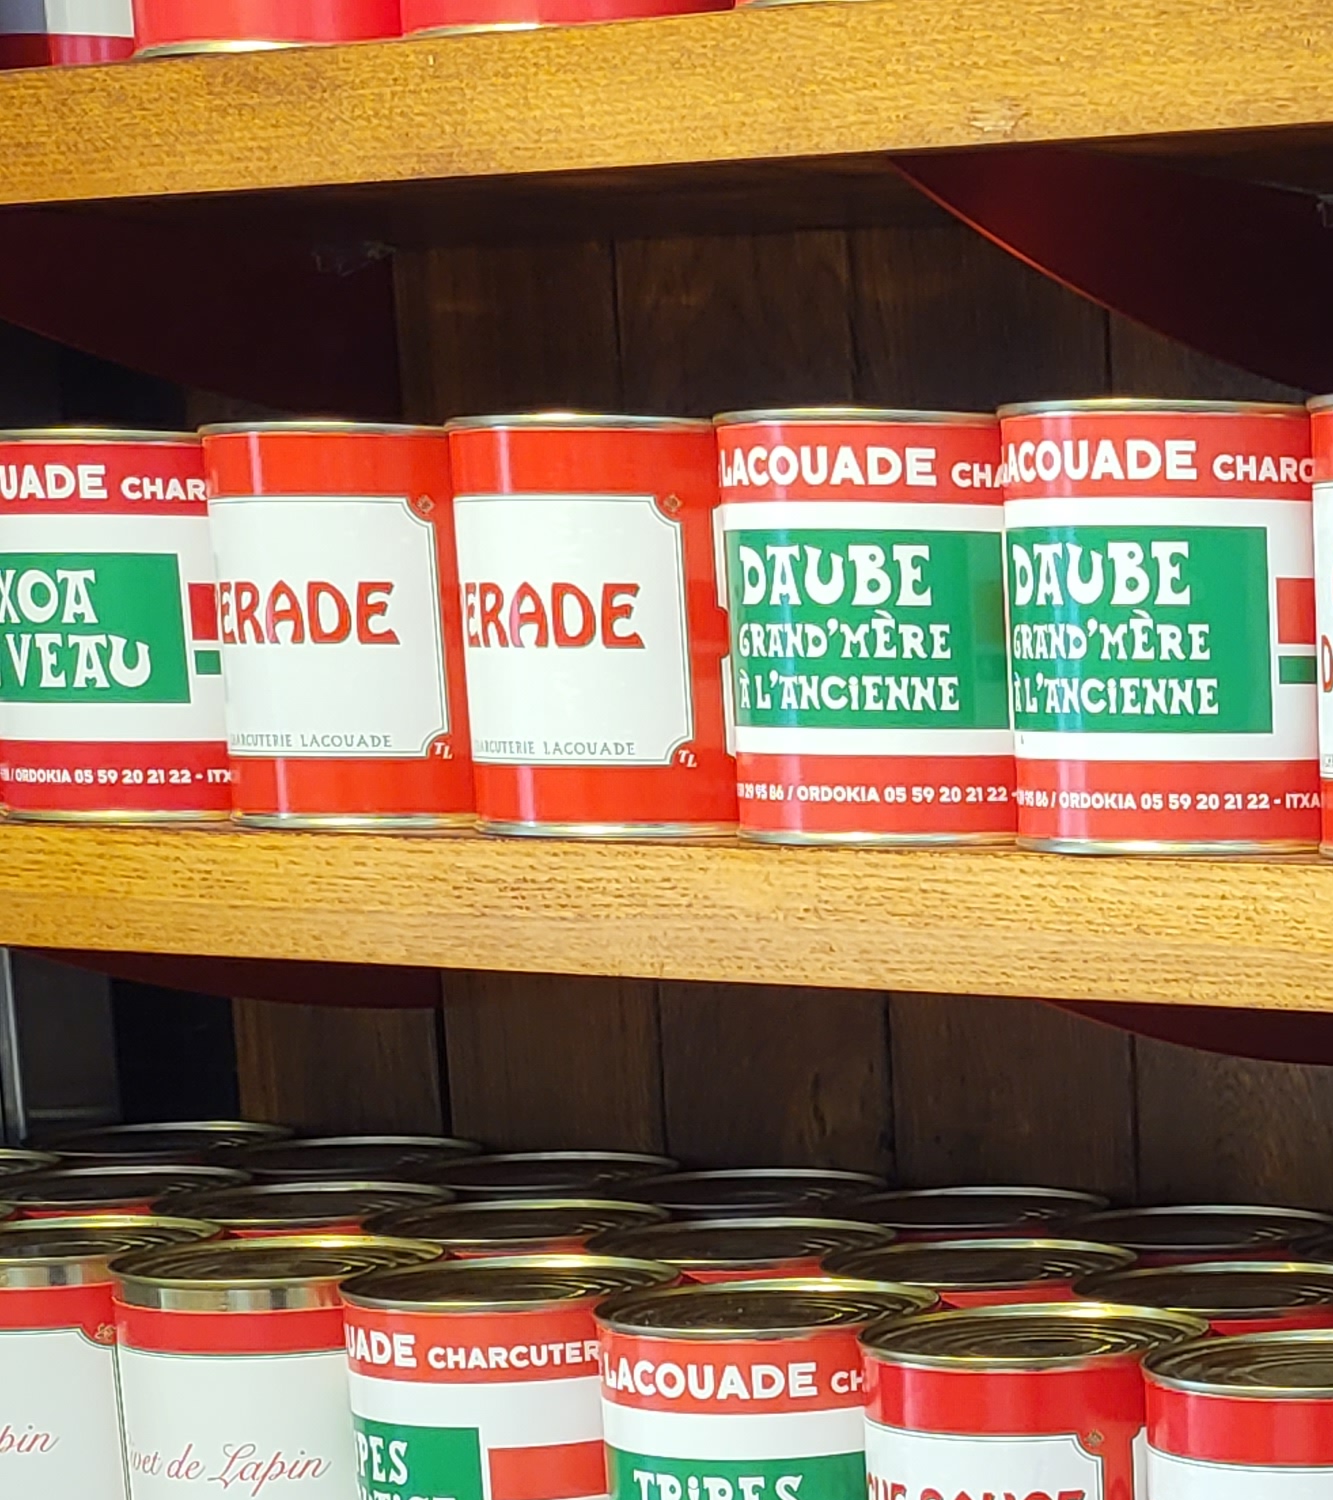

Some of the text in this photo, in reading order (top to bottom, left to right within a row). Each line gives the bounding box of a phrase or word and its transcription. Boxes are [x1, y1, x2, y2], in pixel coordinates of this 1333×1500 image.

[721, 446, 936, 488] LACOUADE
[739, 542, 932, 608] DAUBE
[1014, 540, 1191, 608] DAUBE
[5, 633, 151, 688] VEAU
[739, 610, 951, 660] GRAND'MÈRE
[1012, 609, 1211, 662] GRAND'MÈRE
[300, 734, 392, 749] LACOUADE
[602, 1352, 817, 1401] LACOUADE
[166, 1442, 332, 1498] de Lapin
